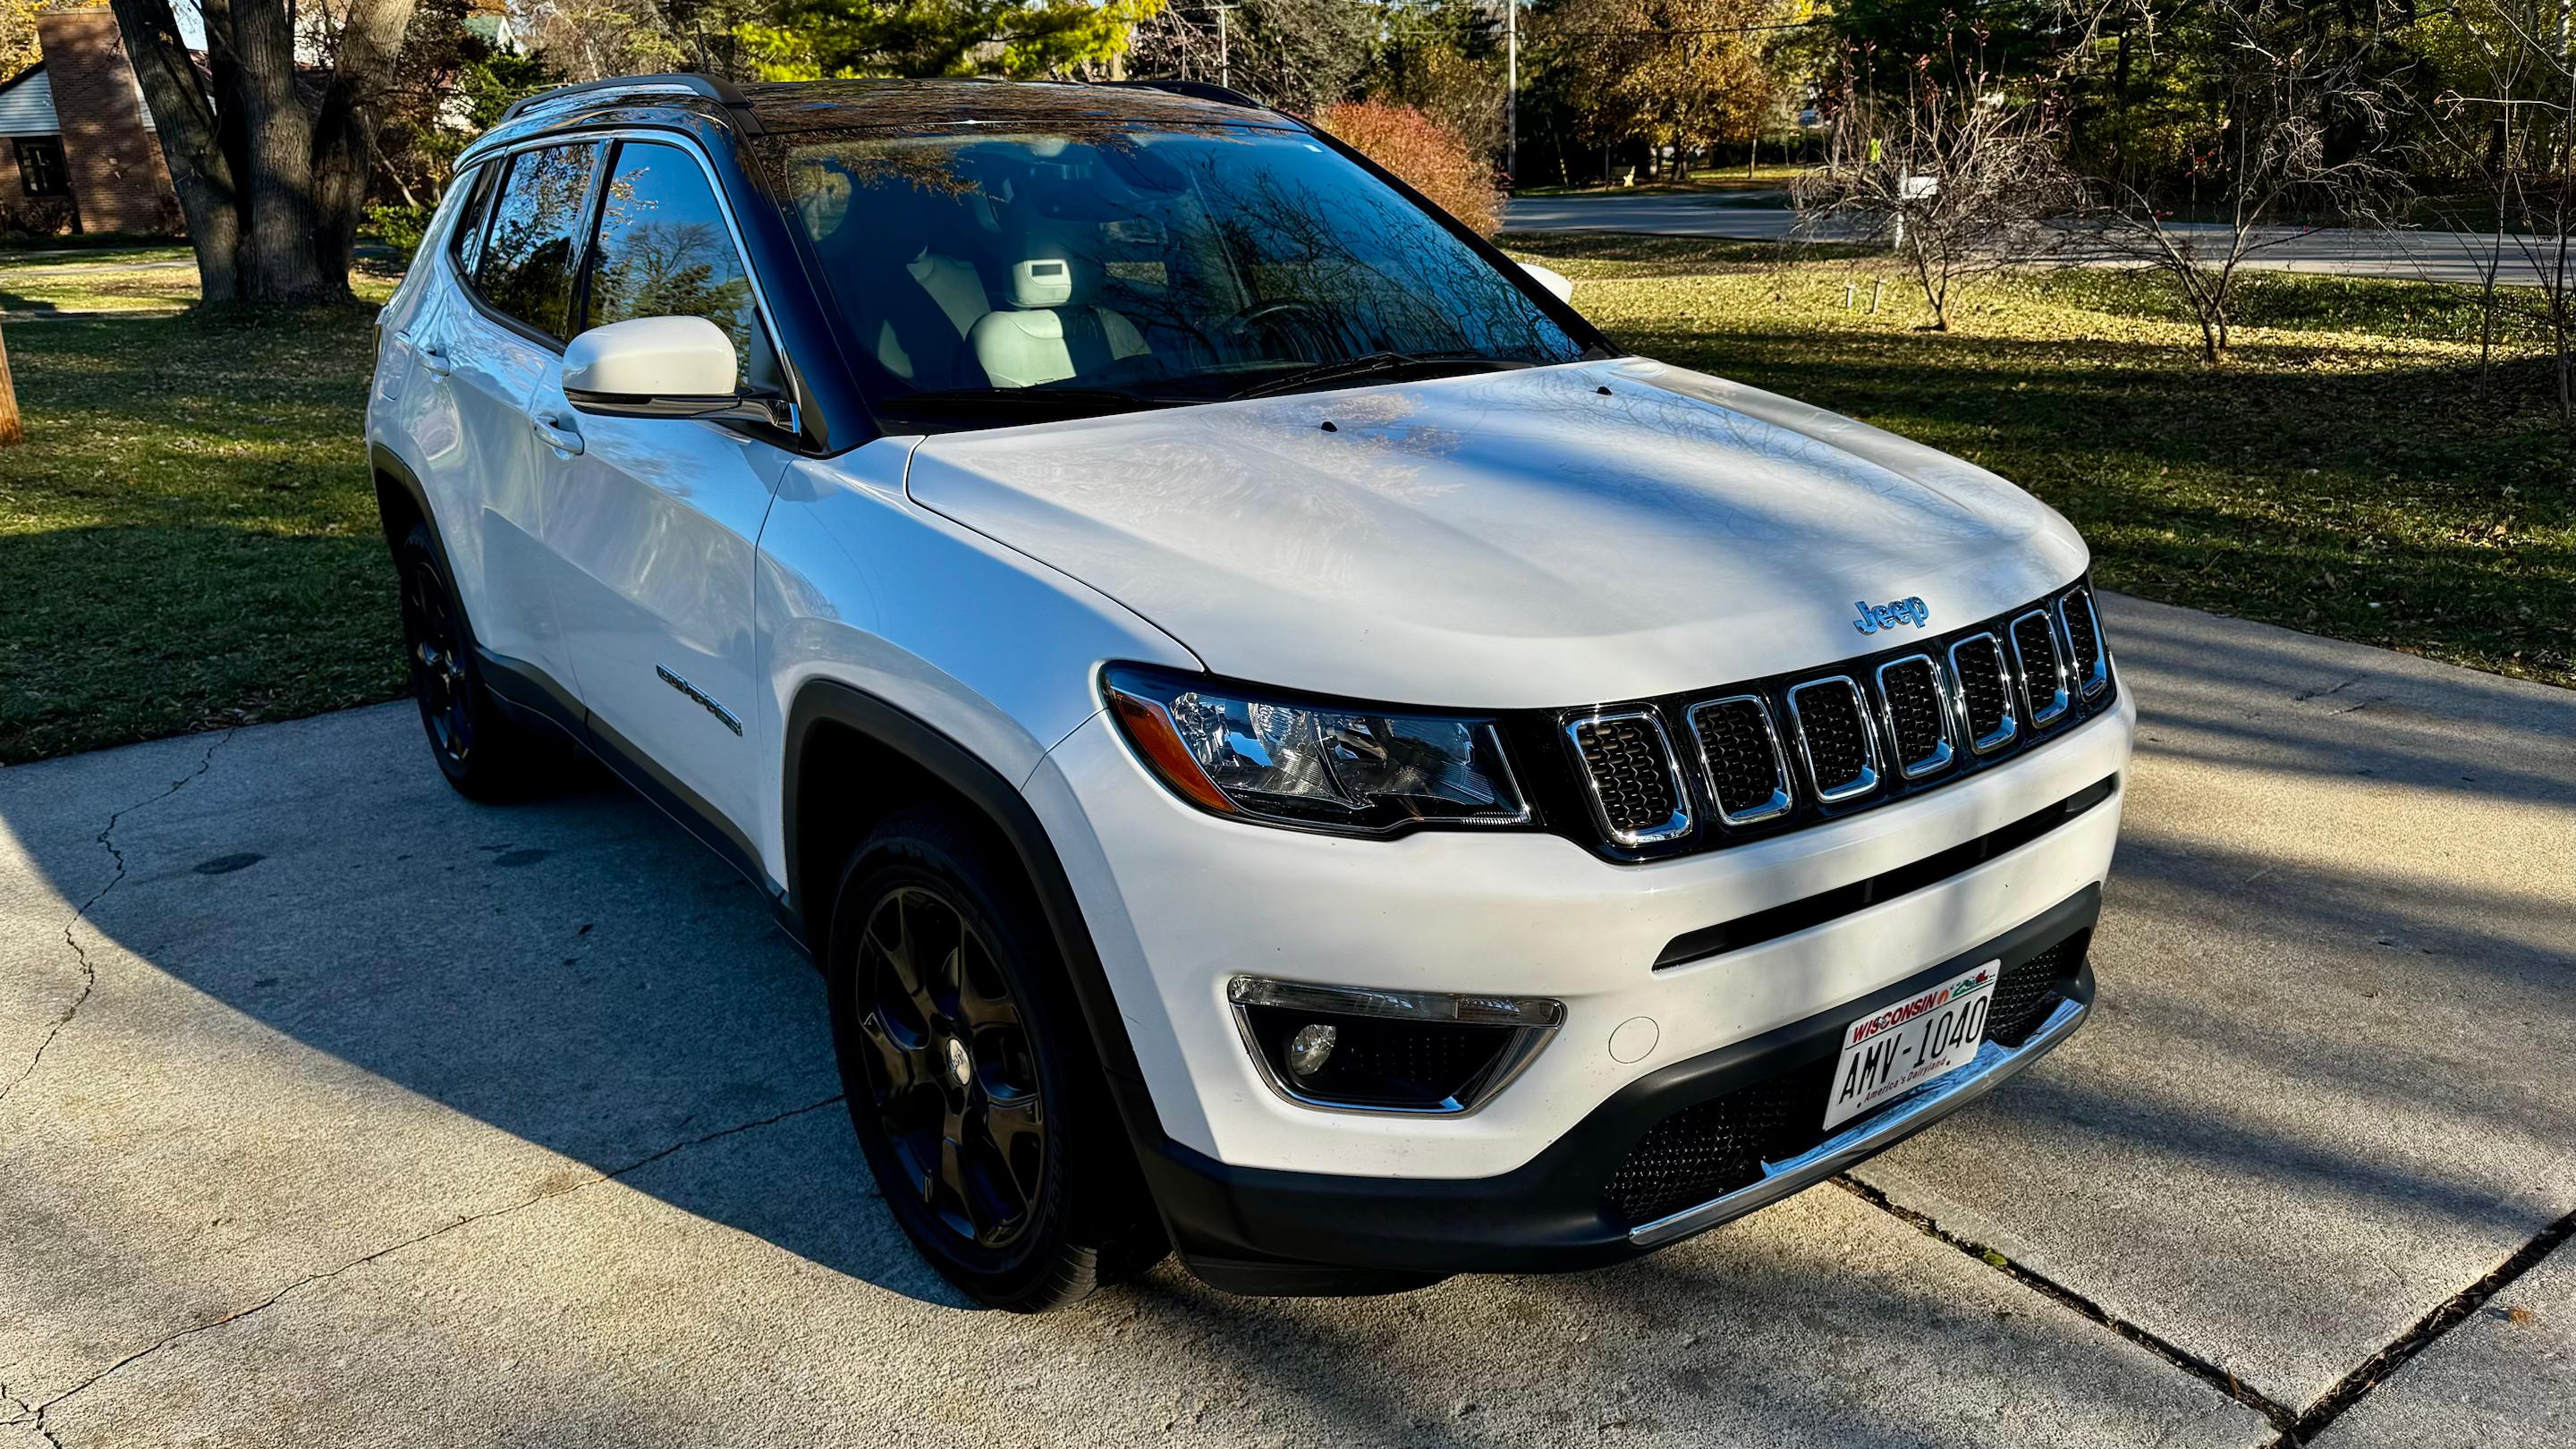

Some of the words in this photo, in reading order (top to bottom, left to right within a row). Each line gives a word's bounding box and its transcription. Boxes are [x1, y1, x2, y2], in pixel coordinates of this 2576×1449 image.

[1852, 596, 1928, 635] Jeep
[1852, 991, 1938, 1043] WISCONSIN
[1838, 995, 1987, 1105] AMV-1040
[1863, 1074, 1906, 1103] America's
[1906, 1055, 1946, 1082] Dairyland
